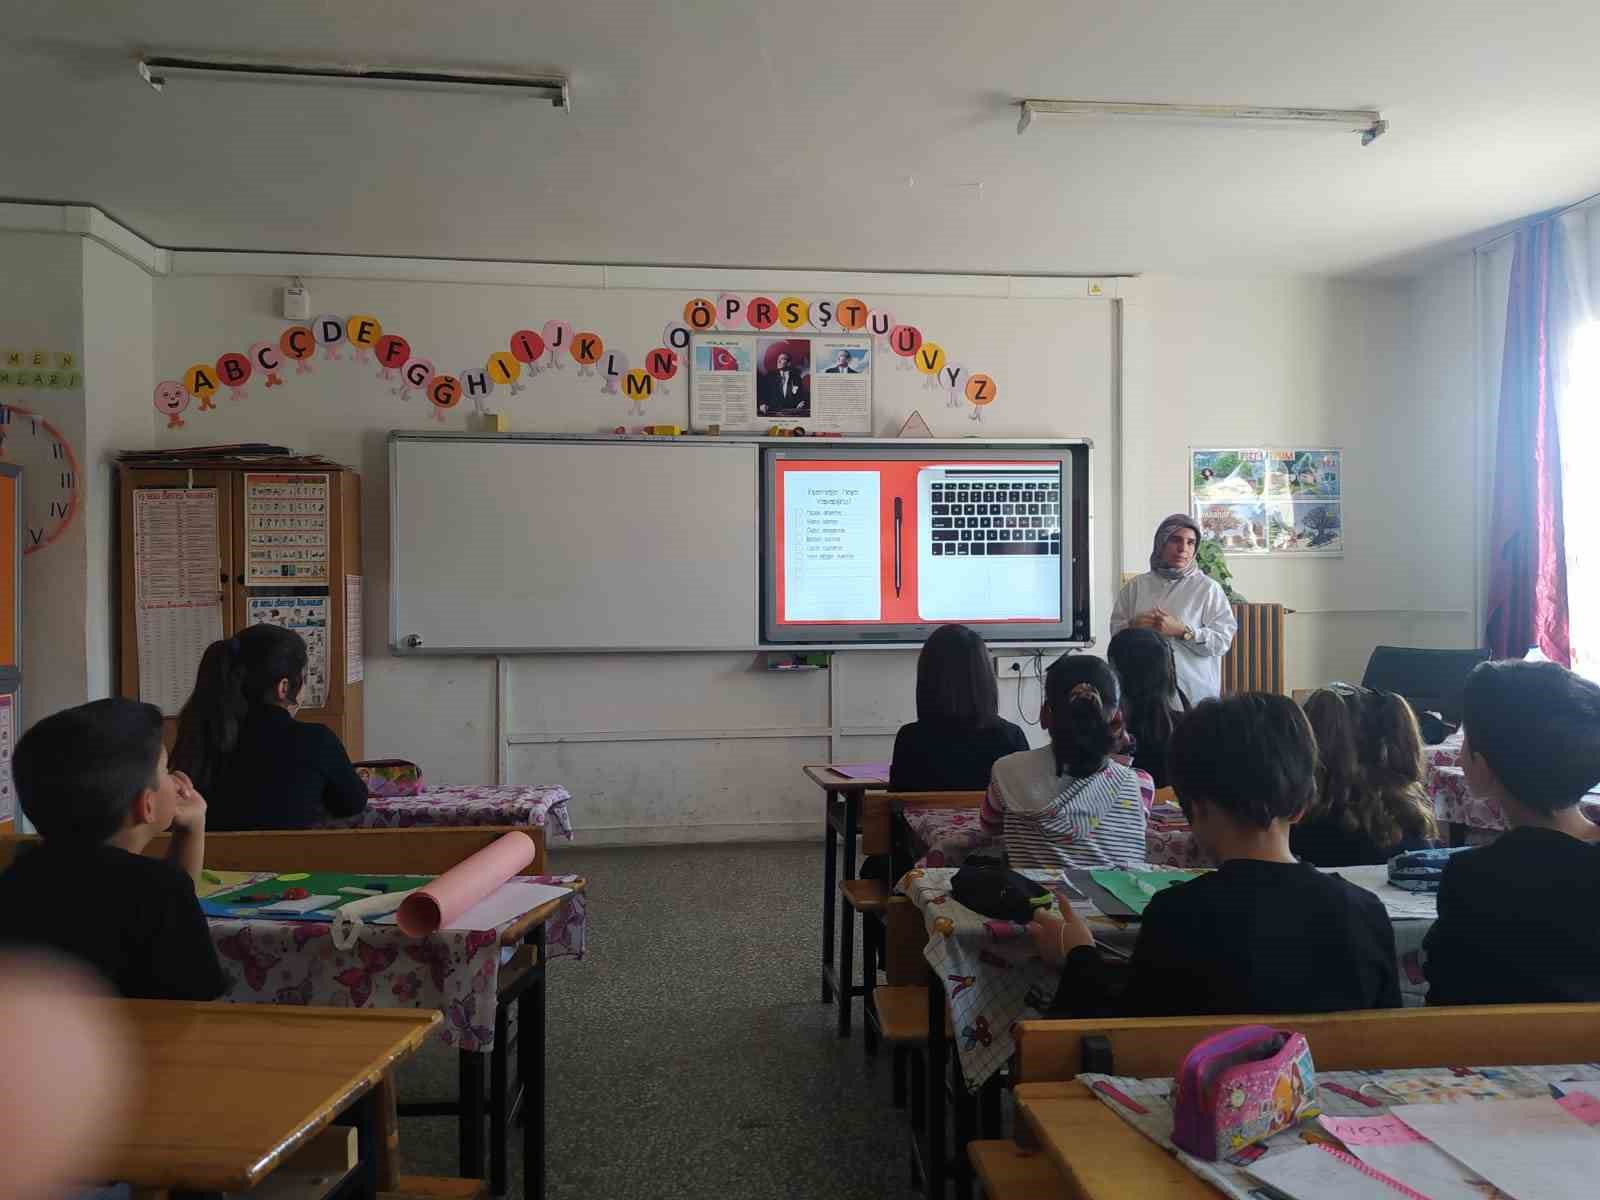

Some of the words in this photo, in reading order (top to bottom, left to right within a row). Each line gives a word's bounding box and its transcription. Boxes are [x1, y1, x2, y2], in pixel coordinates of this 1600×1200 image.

[194, 370, 214, 393] A
[223, 360, 245, 382] B
[258, 348, 278, 369] C
[289, 331, 306, 358] Ç
[323, 321, 342, 342] D
[358, 321, 375, 344] E
[386, 341, 402, 362] F
[407, 364, 429, 385] G
[434, 376, 455, 404] Ğ
[467, 373, 487, 395] H
[498, 359, 511, 379] I
[521, 335, 534, 360] İ
[552, 327, 562, 347] J
[580, 339, 595, 360] K
[608, 355, 619, 376] L
[627, 374, 651, 395] M
[654, 353, 672, 373] N
[670, 327, 690, 348] O
[691, 302, 710, 328] Ö
[726, 299, 740, 320] P
[757, 303, 772, 323] R
[786, 303, 799, 323] S
[819, 302, 832, 327] Ş
[846, 306, 860, 326] T
[872, 314, 888, 334] U
[899, 328, 914, 351] Ü
[922, 350, 938, 369] V
[947, 368, 960, 387] Y
[974, 381, 987, 400] Z
[53, 443, 63, 459] II
[61, 472, 75, 489] III
[50, 502, 68, 518] IV
[30, 528, 43, 544] V
